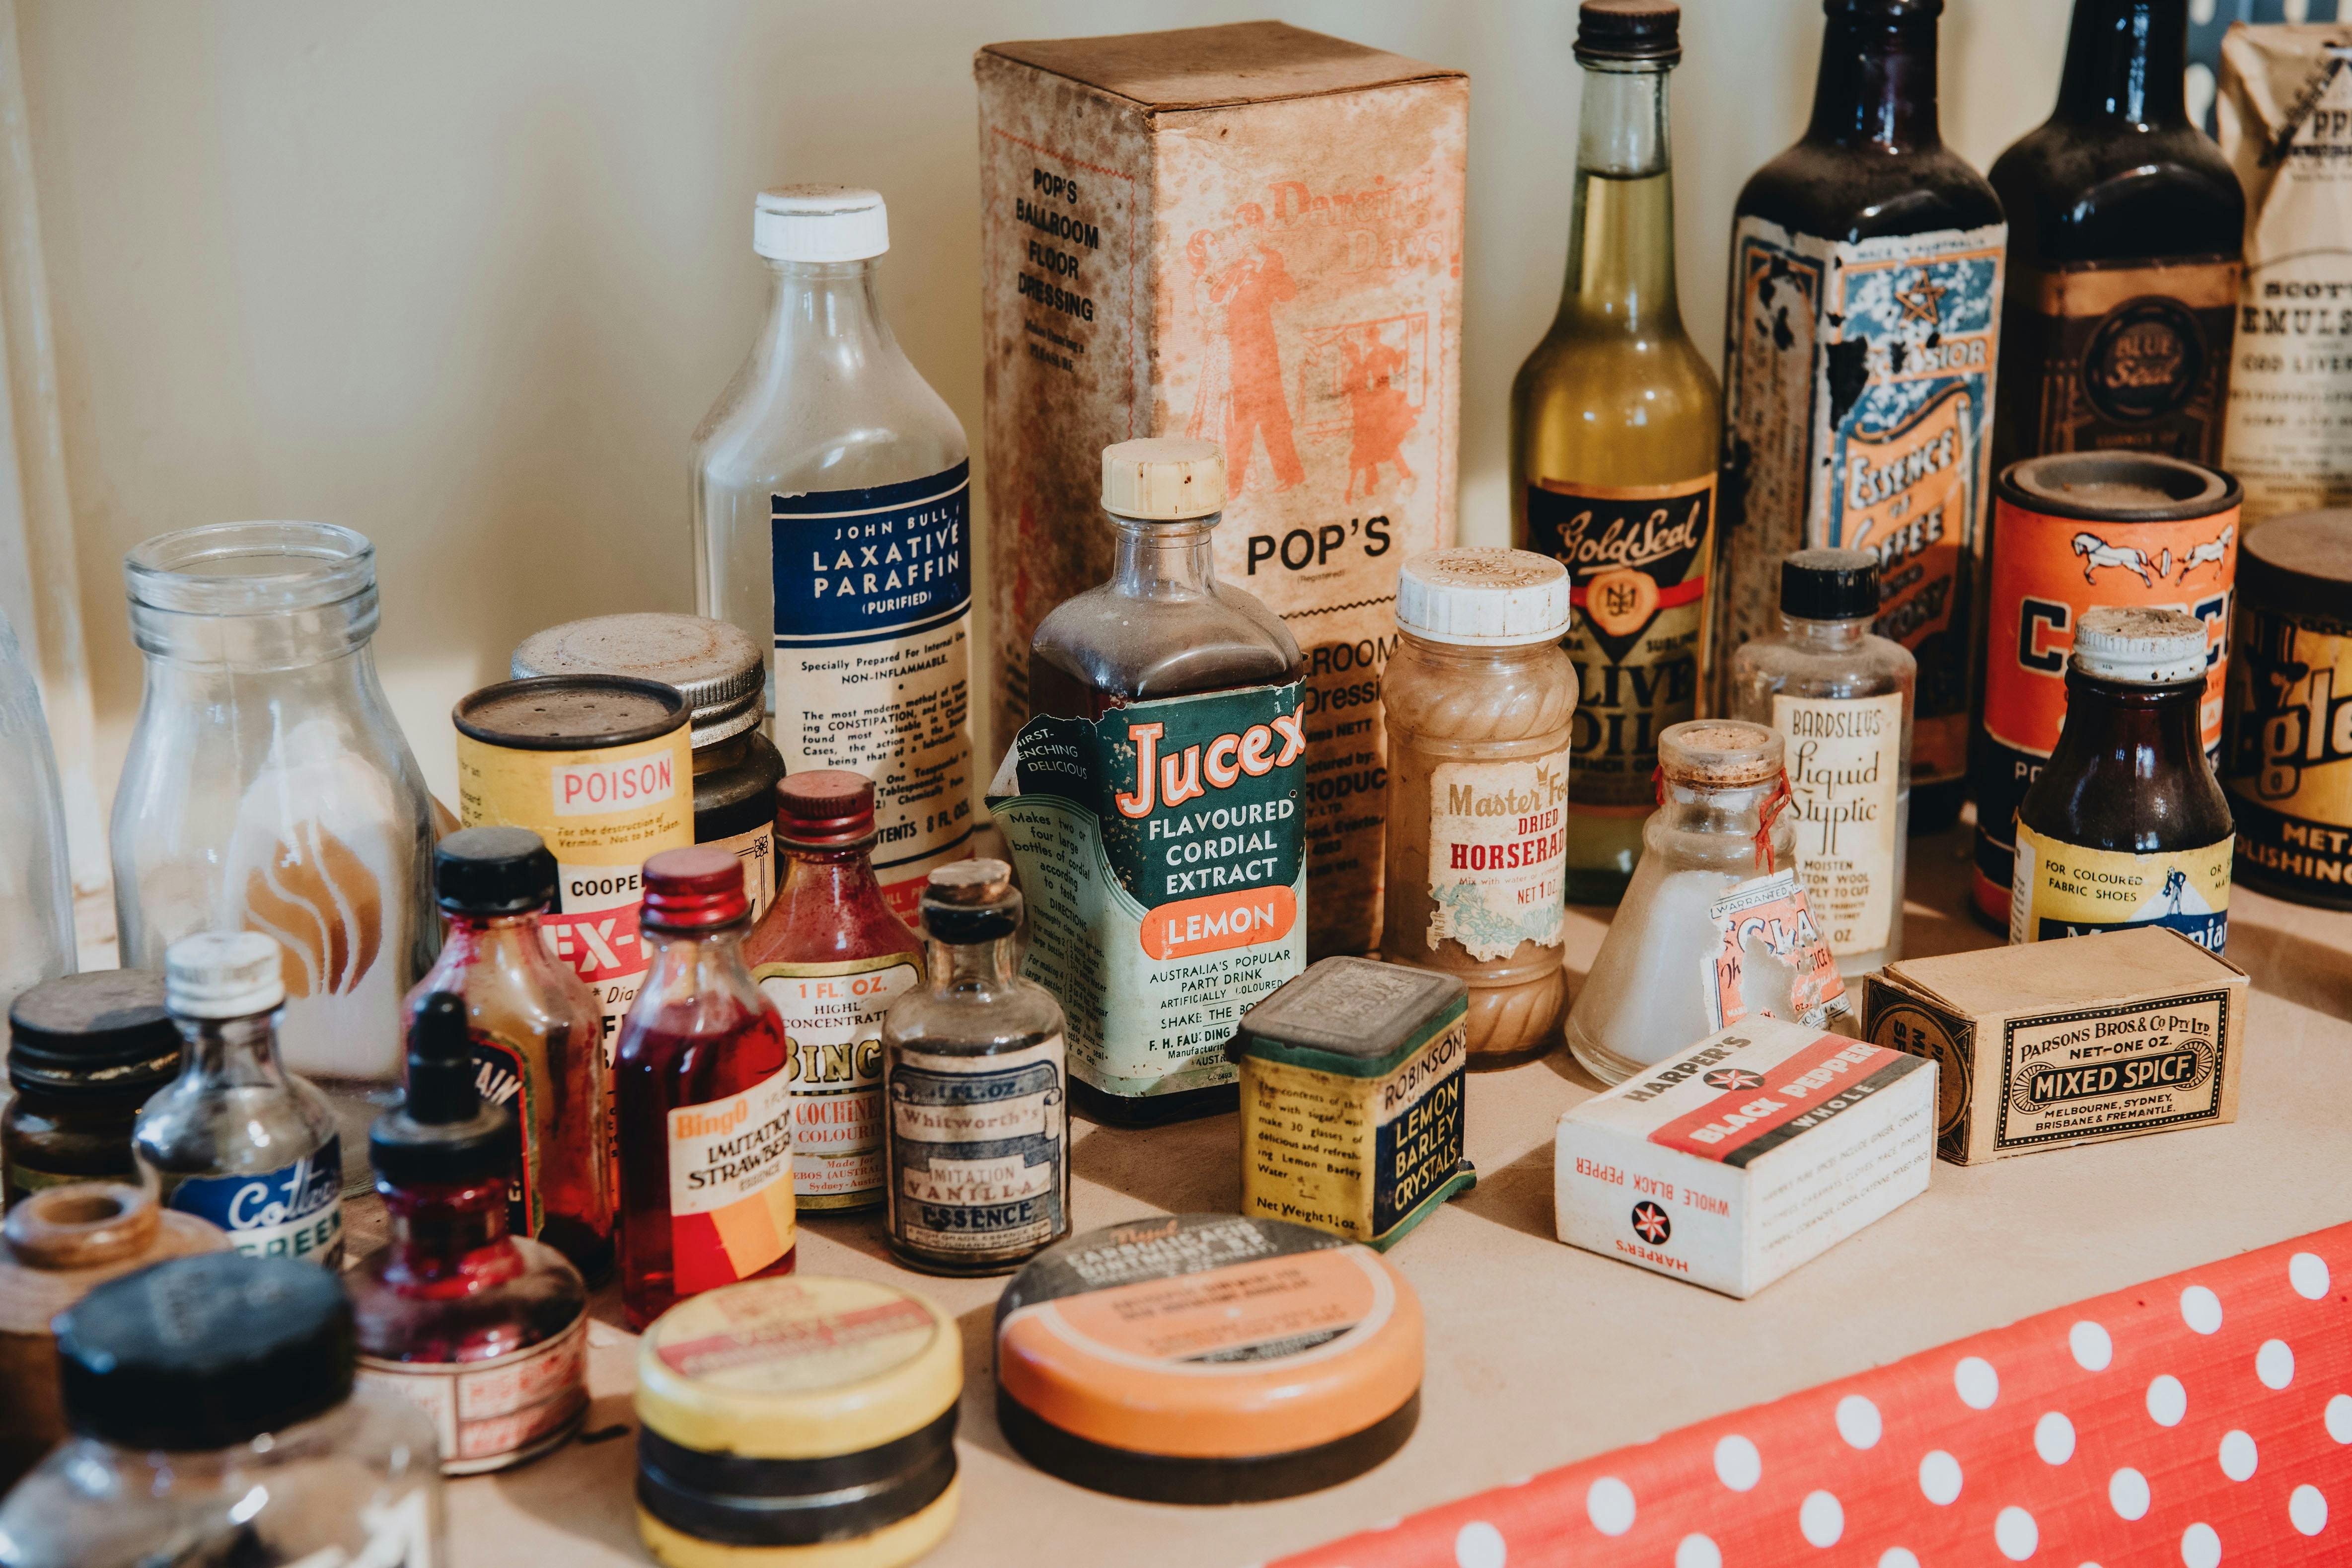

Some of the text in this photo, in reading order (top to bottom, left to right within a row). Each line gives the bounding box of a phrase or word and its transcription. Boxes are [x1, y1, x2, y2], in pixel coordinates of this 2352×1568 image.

[1034, 168, 1077, 204] POP'S
[1016, 198, 1098, 249] BALLROOM
[1029, 240, 1079, 280] FLOOR
[1018, 272, 1093, 322] DRESSING
[2242, 305, 2352, 334] EMULS
[1849, 428, 1954, 510] ESSENCE
[835, 508, 947, 540] JOHN BULL
[813, 523, 959, 571] LAXATIVE
[1247, 515, 1391, 575] POP'S
[814, 551, 959, 598] PARAFFIN
[862, 592, 932, 614] (PURIFIED)
[801, 648, 919, 672] Specially Prepared For
[1307, 634, 1398, 677] ROOM
[1306, 674, 1380, 715] Dressi
[1573, 657, 1696, 707] LIVE
[803, 691, 937, 720] The most modern method
[803, 711, 917, 734] ing CONSTIPATION,
[803, 721, 921, 744] found most valuable
[803, 738, 905, 756] Cases, the action
[828, 753, 886, 766] being that
[1018, 745, 1078, 762] ENCHING
[1115, 702, 1306, 819] Jucex
[564, 758, 671, 804] POISON
[1028, 761, 1088, 780] DELICIOUS
[1790, 740, 1879, 800] Liquid
[1306, 768, 1387, 803] RODUC
[1449, 783, 1543, 818] Master
[600, 819, 654, 835] destruction
[879, 821, 917, 844] TENTS
[1010, 811, 1086, 842] Makes two or
[1149, 799, 1294, 840] FLAVOURED
[1518, 808, 1558, 835] DRIED
[1790, 789, 1878, 855] Styptic
[1030, 826, 1079, 855] four large
[1166, 830, 1277, 866] CORDIAL
[1451, 826, 1566, 871] HORSERAD
[2283, 822, 2352, 855] MET
[1012, 839, 1090, 881] bottles of cordial
[1805, 861, 1853, 871] MOISTEN
[2046, 860, 2143, 886] FOR COLOURED
[572, 875, 641, 896] COOPE
[1040, 861, 1078, 893] according
[1167, 857, 1277, 895] EXTRACT
[1505, 876, 1527, 884] water
[1837, 873, 1869, 883] WOOL
[2050, 878, 2136, 902] FABRIC SHOES
[1044, 876, 1078, 906] to taste.
[1517, 886, 1537, 905] NET
[1717, 887, 1787, 914] WARRANTED
[1033, 905, 1075, 938] Thoroughly clean
[1050, 897, 1087, 933] DIRECTIONS
[1169, 903, 1274, 945] LEMON
[1033, 934, 1064, 960] large bottles
[1044, 928, 1061, 945] making
[1028, 954, 1058, 978] For making
[1150, 950, 1290, 983] AUSTRALIA'S POPULAR
[1182, 969, 1262, 992] PARTY DRINK
[799, 976, 887, 999] 1 FL. OZ.
[1026, 968, 1062, 994] large bottles
[1161, 990, 1226, 1009] ARTIFICIALLY
[783, 1009, 888, 1029] CONCENTRAT
[1161, 1013, 1202, 1029] SHAKE
[1209, 1007, 1232, 1020] THE
[2021, 1029, 2090, 1063] PARSONS
[2149, 1036, 2172, 1047] OZ.
[1622, 1036, 1752, 1103] HARPER'S
[2036, 1067, 2117, 1099] MIXED
[1689, 1097, 1788, 1144] BLACK
[1778, 1044, 1881, 1098] PEPPER
[1791, 1083, 1876, 1128] WHOLE
[2045, 1093, 2172, 1119] MELBOURNE, SYDNEY,
[796, 1096, 879, 1125] COCHINE
[903, 1108, 1038, 1130] Whitworth's
[1396, 1076, 1459, 1148] LEMON
[2036, 1104, 2175, 1131] BRISBANE FREMANTLE.
[798, 1123, 882, 1143] COLOURIN
[1258, 1117, 1342, 1141] make 30 glasses
[1258, 1132, 1319, 1153] delicious and
[1396, 1107, 1458, 1180] BARLEY
[688, 1131, 791, 1190] STRAWBER
[827, 1156, 875, 1168] Made for
[929, 1165, 1016, 1183] IMITATION
[1258, 1149, 1362, 1180] ing Lemon Barley
[1258, 1163, 1288, 1179] Water
[1395, 1137, 1457, 1211] CRYSTALS
[908, 1180, 1034, 1201] VANILLA
[1577, 1157, 1730, 1218] WHOLE BLACK PEPPER
[922, 1202, 1033, 1228] ESSENCE
[1257, 1196, 1323, 1222] Net Weight
[1616, 1240, 1688, 1272] HARPER'S
